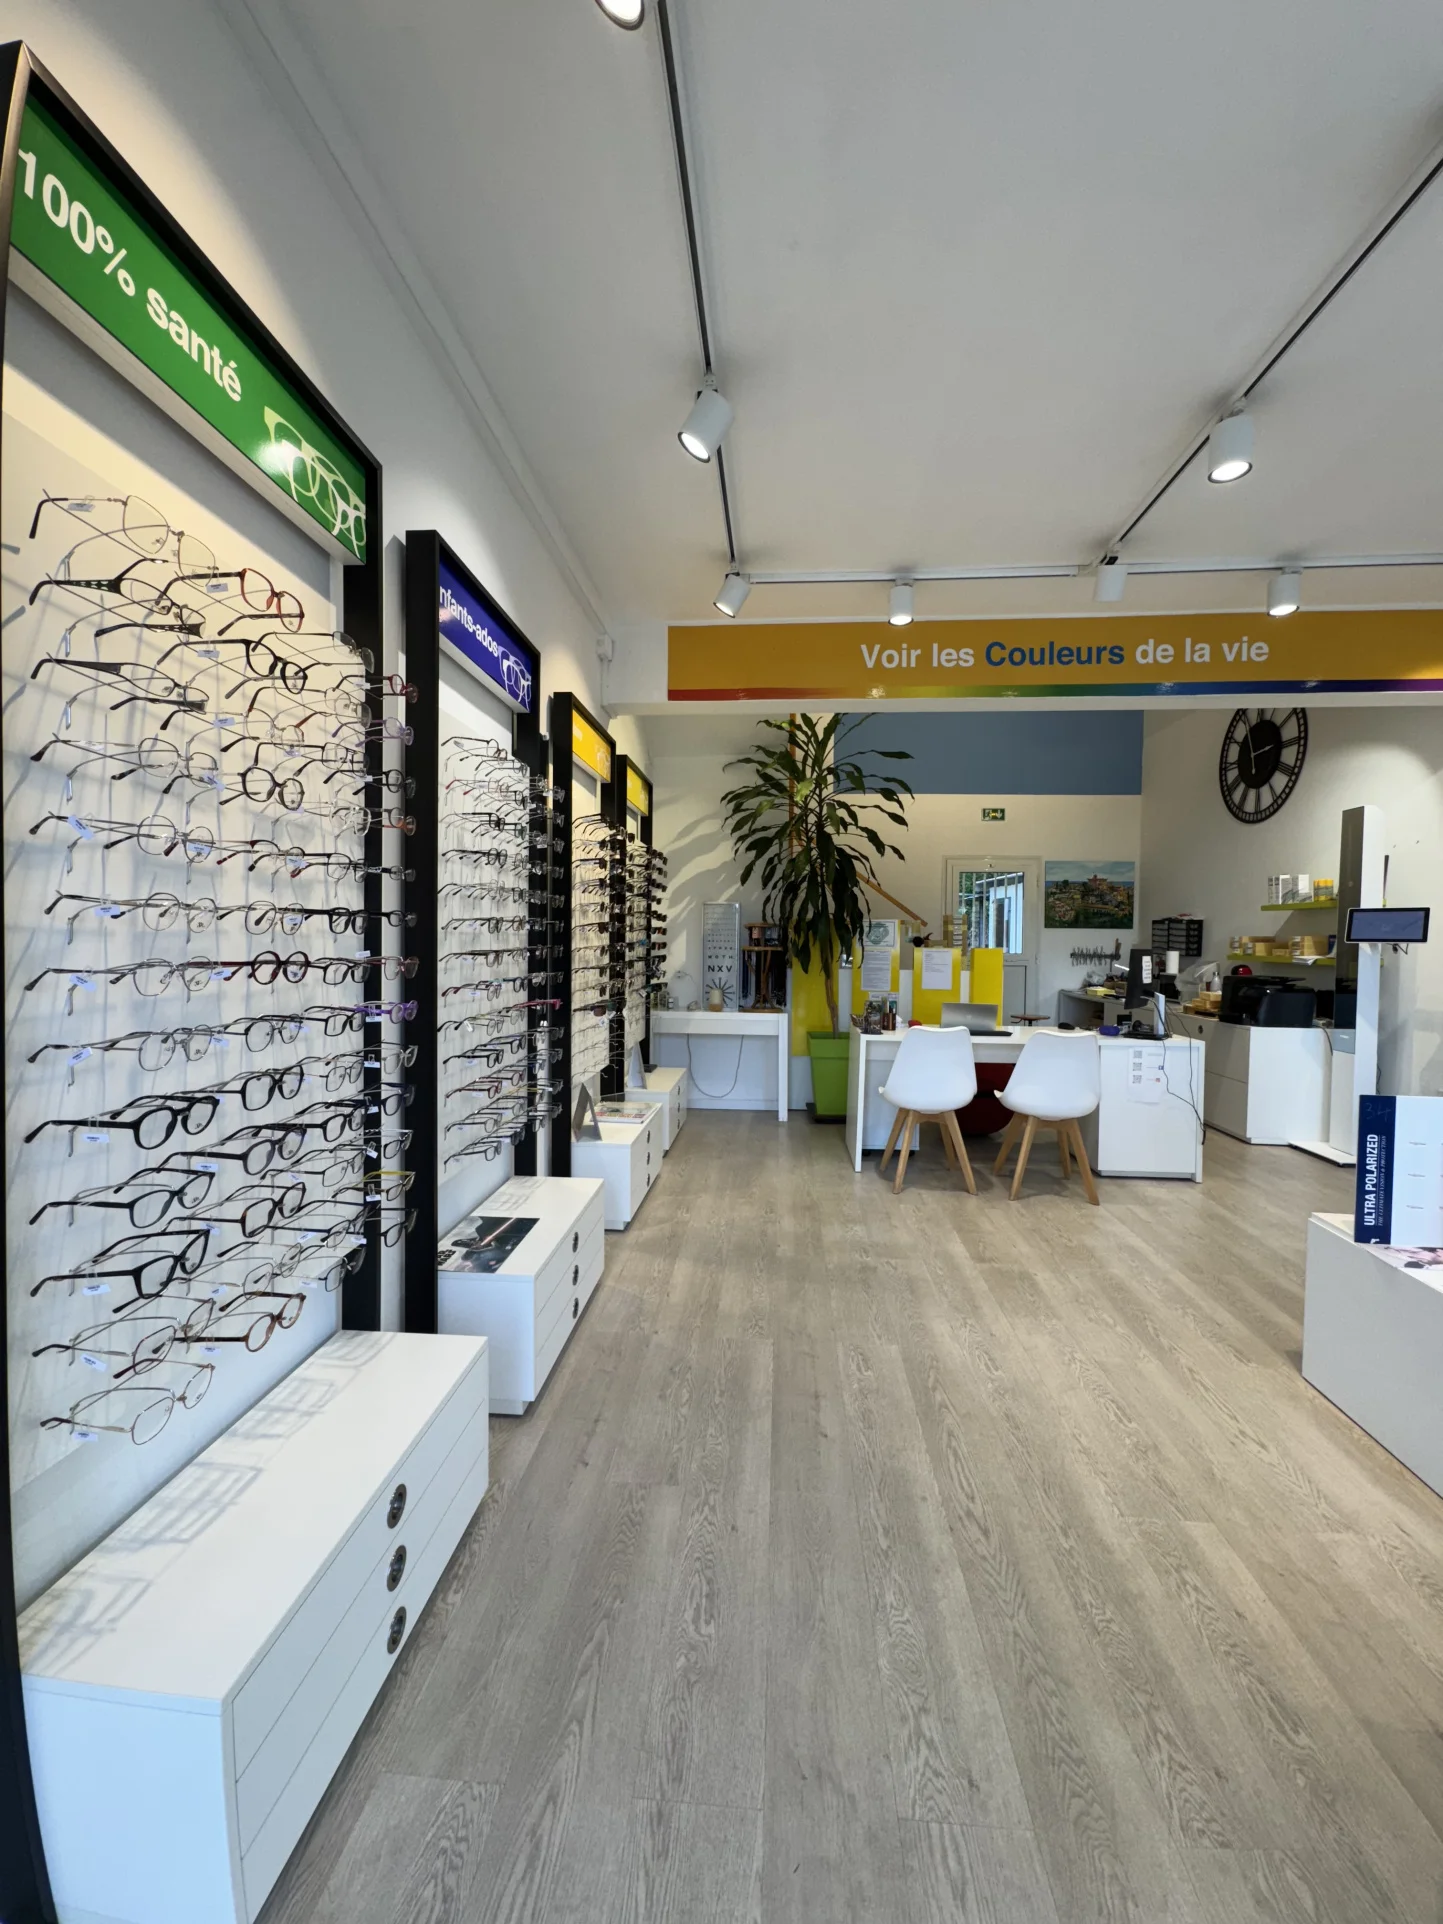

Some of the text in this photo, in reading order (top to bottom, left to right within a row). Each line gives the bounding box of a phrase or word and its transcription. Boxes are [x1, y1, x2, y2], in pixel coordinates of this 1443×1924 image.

[18, 149, 242, 402] 100% santé
[440, 586, 499, 657] nfants-ados
[860, 636, 1269, 669] Voir les Couleurs de la vie
[1363, 1134, 1378, 1226] ULTRA POLARIZED
